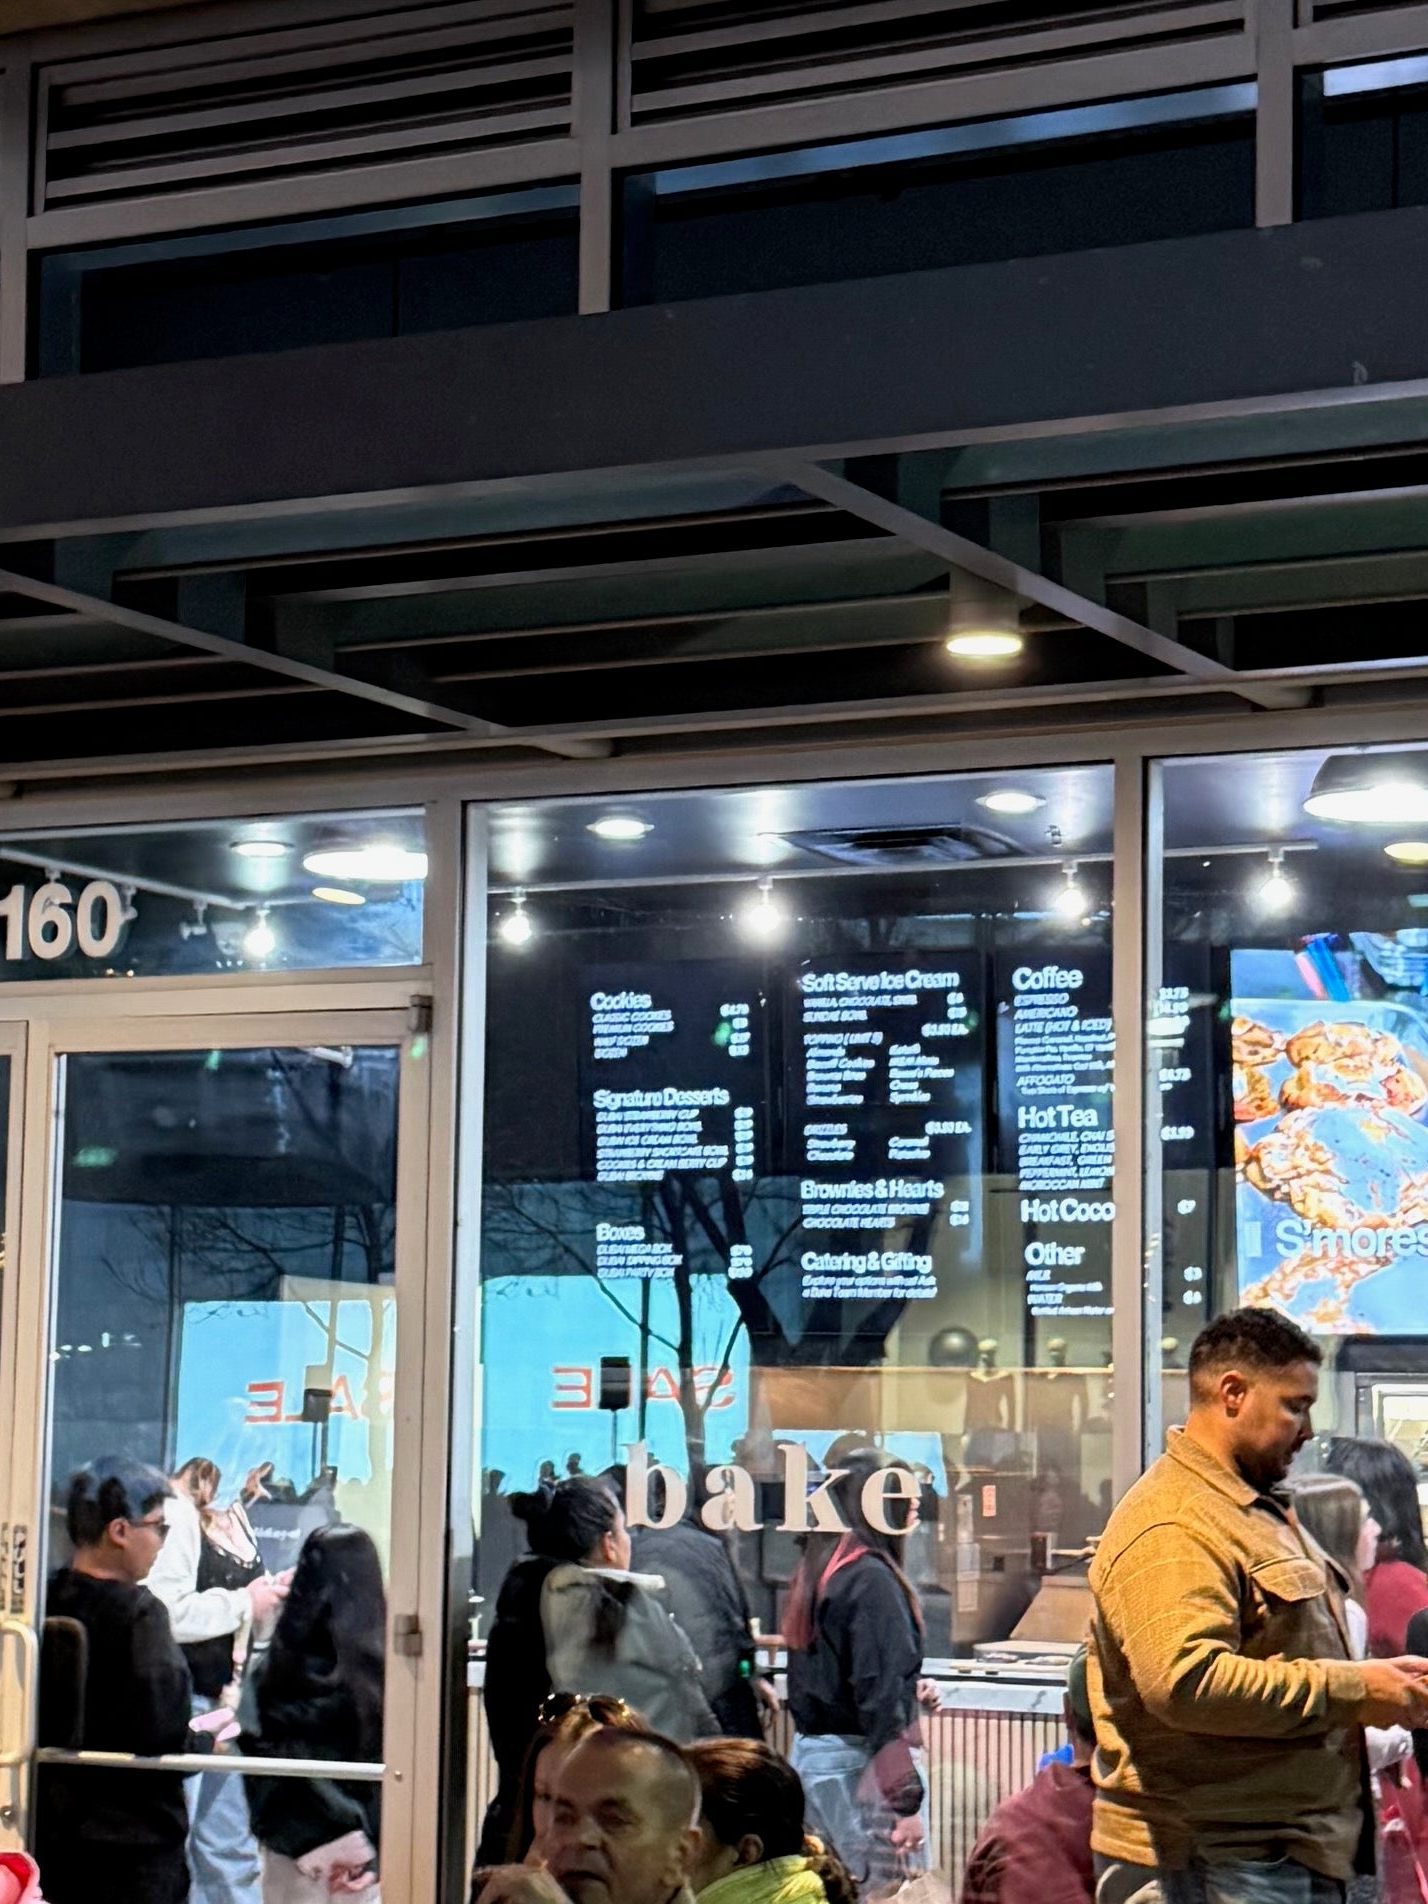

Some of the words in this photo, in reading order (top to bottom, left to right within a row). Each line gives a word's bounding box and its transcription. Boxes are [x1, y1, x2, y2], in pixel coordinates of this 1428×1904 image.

[802, 973, 835, 992] Soft
[880, 971, 904, 990] Ice
[905, 969, 960, 989] Cream
[1012, 965, 1083, 990] Coffee
[590, 991, 652, 1011] Cookies
[593, 1089, 662, 1110] Signature
[663, 1087, 731, 1106] Desserts
[1018, 1106, 1057, 1128] Hot
[1057, 1104, 1099, 1127] Tea
[801, 1179, 873, 1199] Brownies
[874, 1178, 888, 1199] &
[889, 1179, 945, 1198] Hearts
[1020, 1199, 1060, 1223] Hot
[1060, 1197, 1116, 1222] Coco
[596, 1222, 645, 1242] Boxes
[801, 1250, 867, 1274] Catering
[867, 1250, 881, 1271] &
[881, 1250, 933, 1274] Gifting
[1024, 1241, 1086, 1266] Other
[620, 1439, 923, 1537] bake
